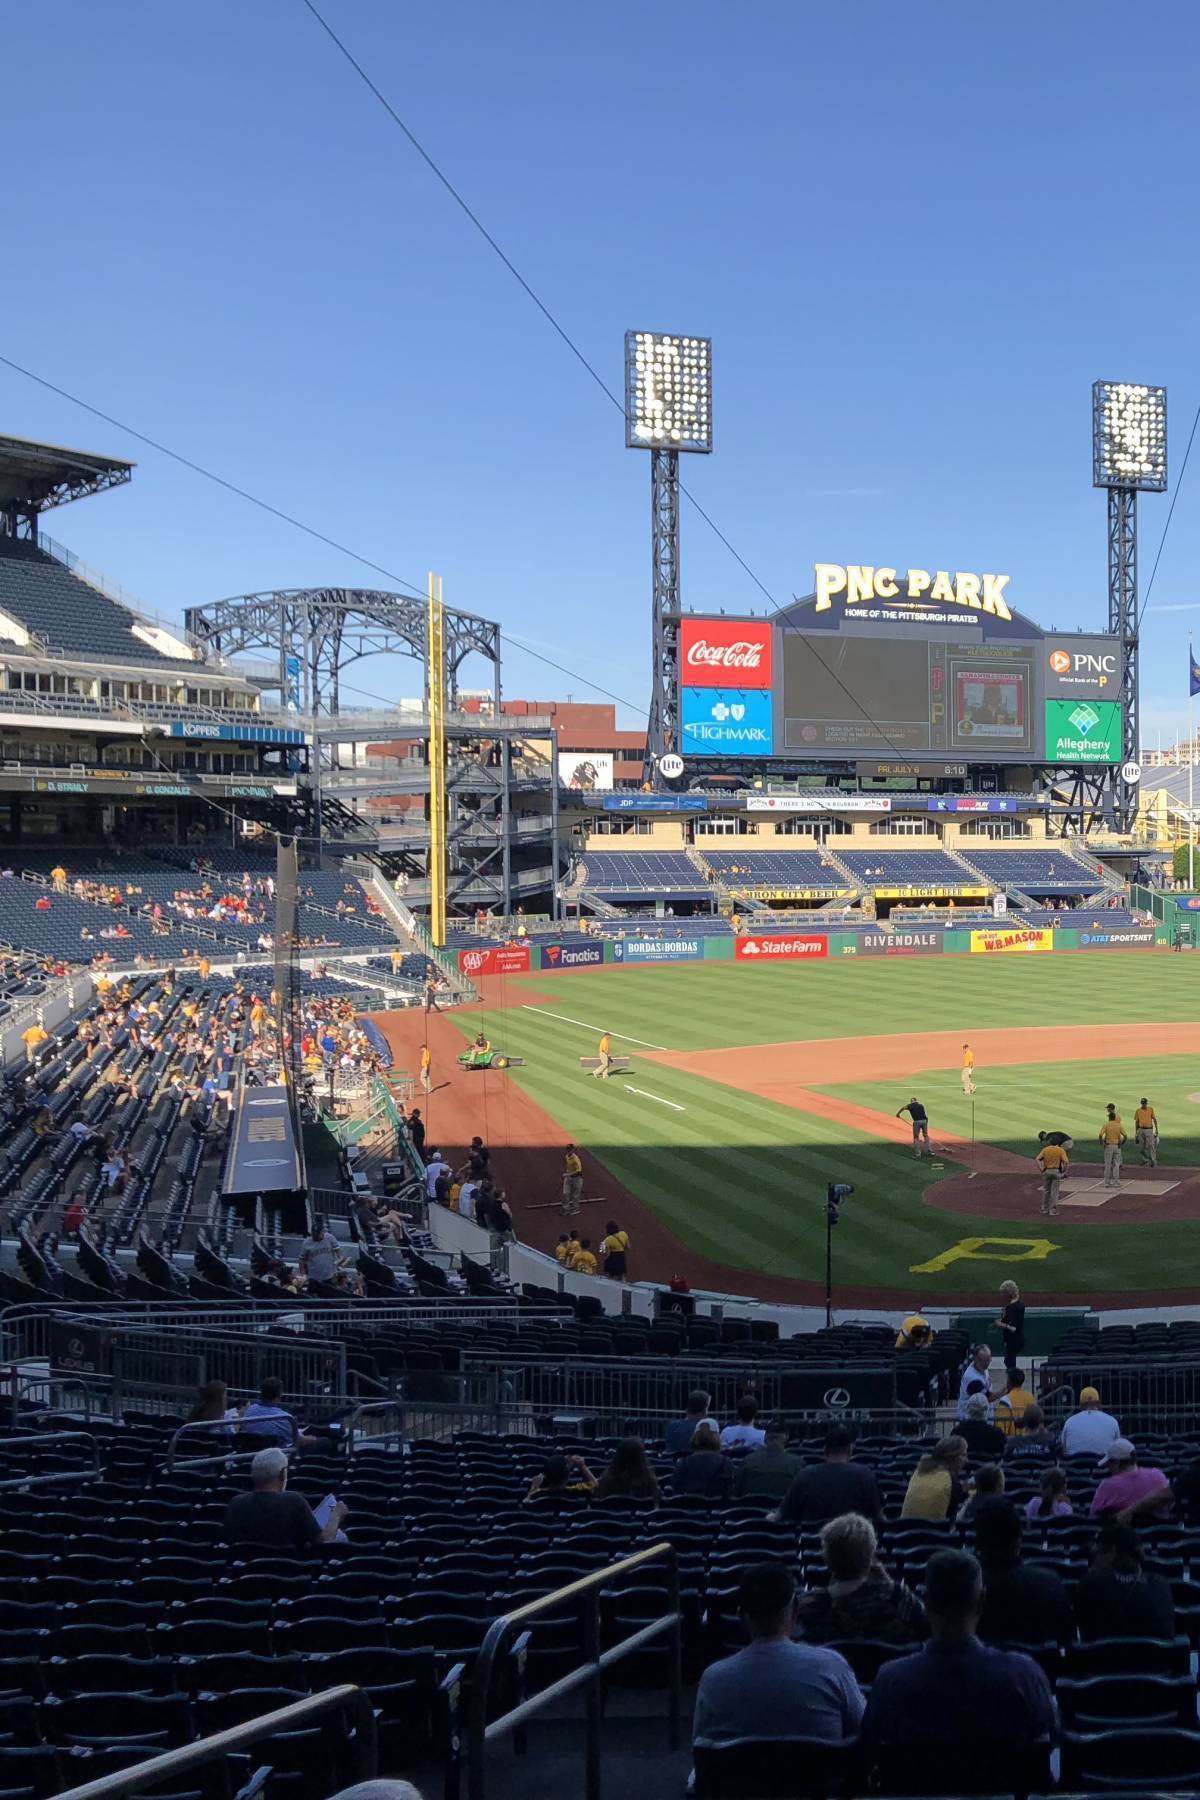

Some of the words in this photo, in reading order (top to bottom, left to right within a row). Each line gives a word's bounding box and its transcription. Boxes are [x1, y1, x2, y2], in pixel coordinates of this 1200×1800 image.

[815, 563, 899, 613] PNC
[907, 568, 1012, 621] PARK
[845, 608, 868, 617] HOME
[869, 610, 880, 618] OF
[881, 610, 897, 619] THE
[899, 611, 946, 622] PITTSBURGH
[947, 614, 978, 624] PIRATES
[1072, 654, 1116, 673] PNC
[183, 723, 220, 737] KOPPERS
[693, 723, 768, 741] HIGHMARK
[1056, 738, 1110, 752] Allegheny
[1056, 752, 1079, 760] Health
[1080, 752, 1110, 761] Network
[663, 759, 681, 772] Lite
[893, 766, 913, 774] JULY
[944, 766, 965, 774] 6:10
[1124, 766, 1140, 777] Lite
[749, 890, 777, 899] IRON
[781, 890, 806, 899] CITY
[810, 890, 839, 898] BEER
[910, 889, 939, 897] LIGHT
[942, 888, 963, 896] BEER
[864, 934, 937, 947] RIVENDALE
[1091, 934, 1109, 942] AT&T
[1109, 934, 1153, 942] SPORTSNET
[628, 943, 660, 953] BORDAS
[665, 941, 698, 952] BORDAS
[561, 949, 600, 964] Fanatics
[908, 1236, 1063, 1274] P
